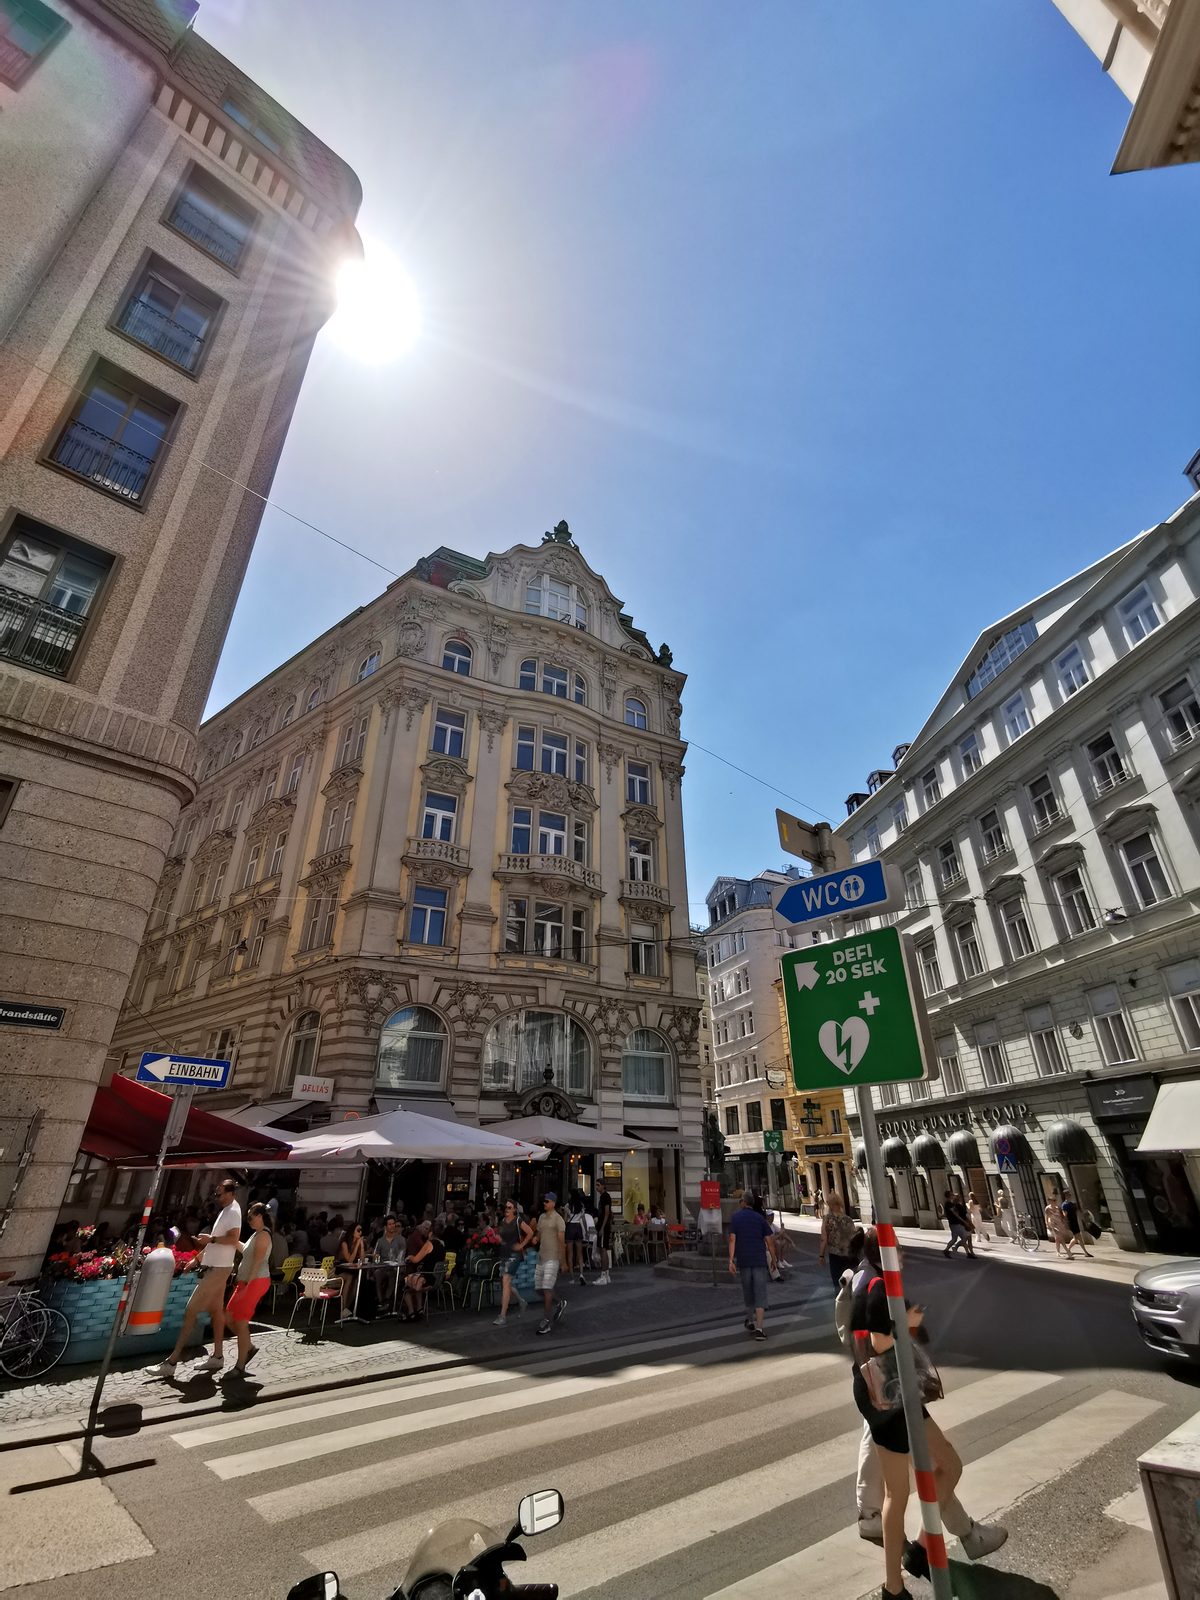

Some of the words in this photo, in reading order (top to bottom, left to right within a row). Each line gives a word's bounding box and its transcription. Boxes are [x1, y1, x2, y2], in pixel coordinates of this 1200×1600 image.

[801, 881, 839, 913] WC
[832, 943, 873, 966] DEFI
[825, 967, 847, 985] 20
[850, 958, 887, 979] SEK
[168, 1063, 220, 1079] EINBAHN
